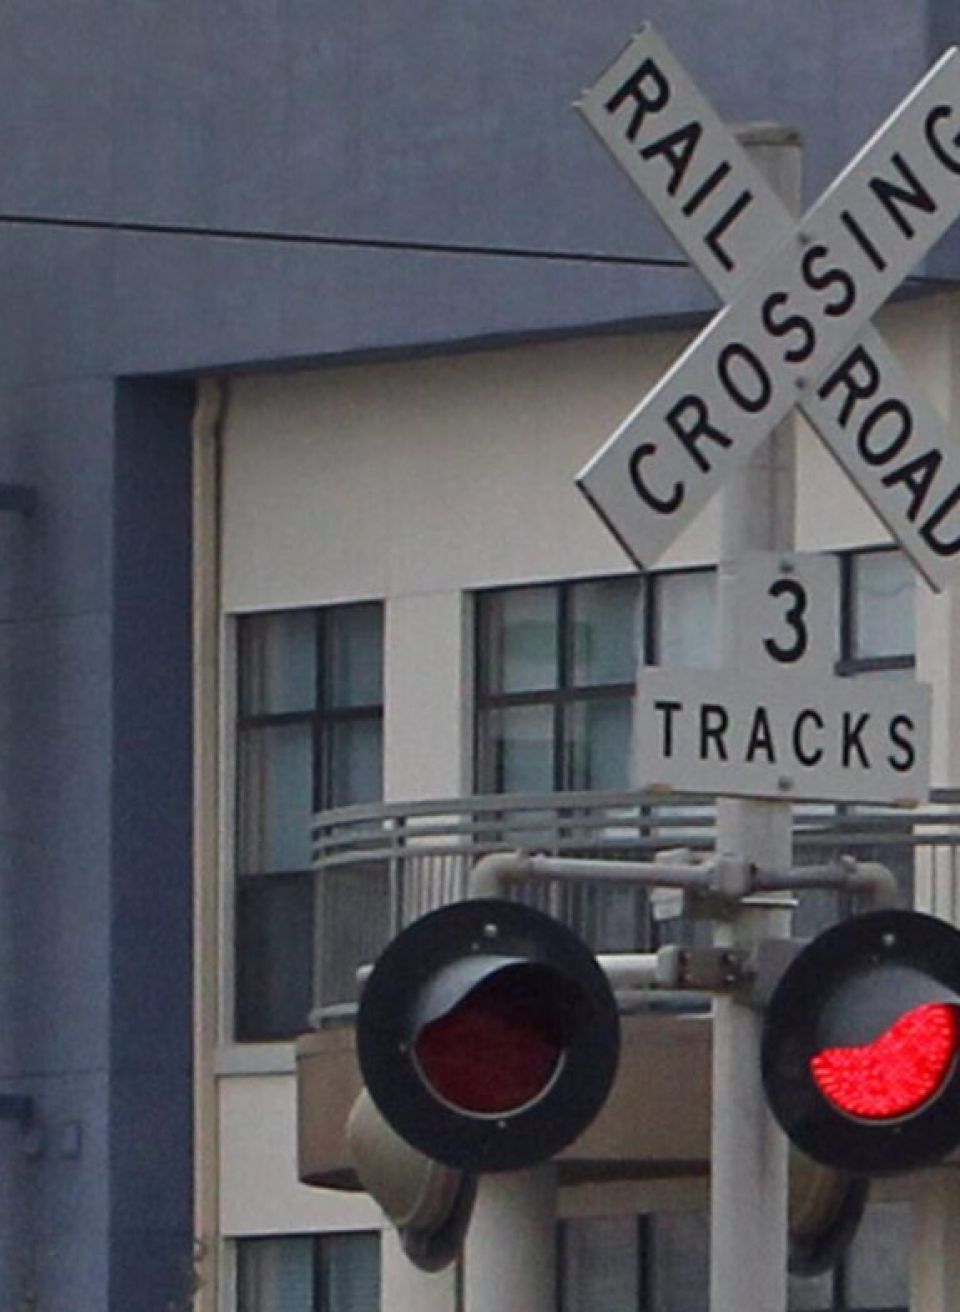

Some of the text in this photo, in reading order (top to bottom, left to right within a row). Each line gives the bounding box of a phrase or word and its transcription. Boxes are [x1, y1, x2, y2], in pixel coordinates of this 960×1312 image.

[606, 57, 753, 273] RAIL
[763, 579, 808, 664] 3
[654, 701, 915, 772] TRACKS
